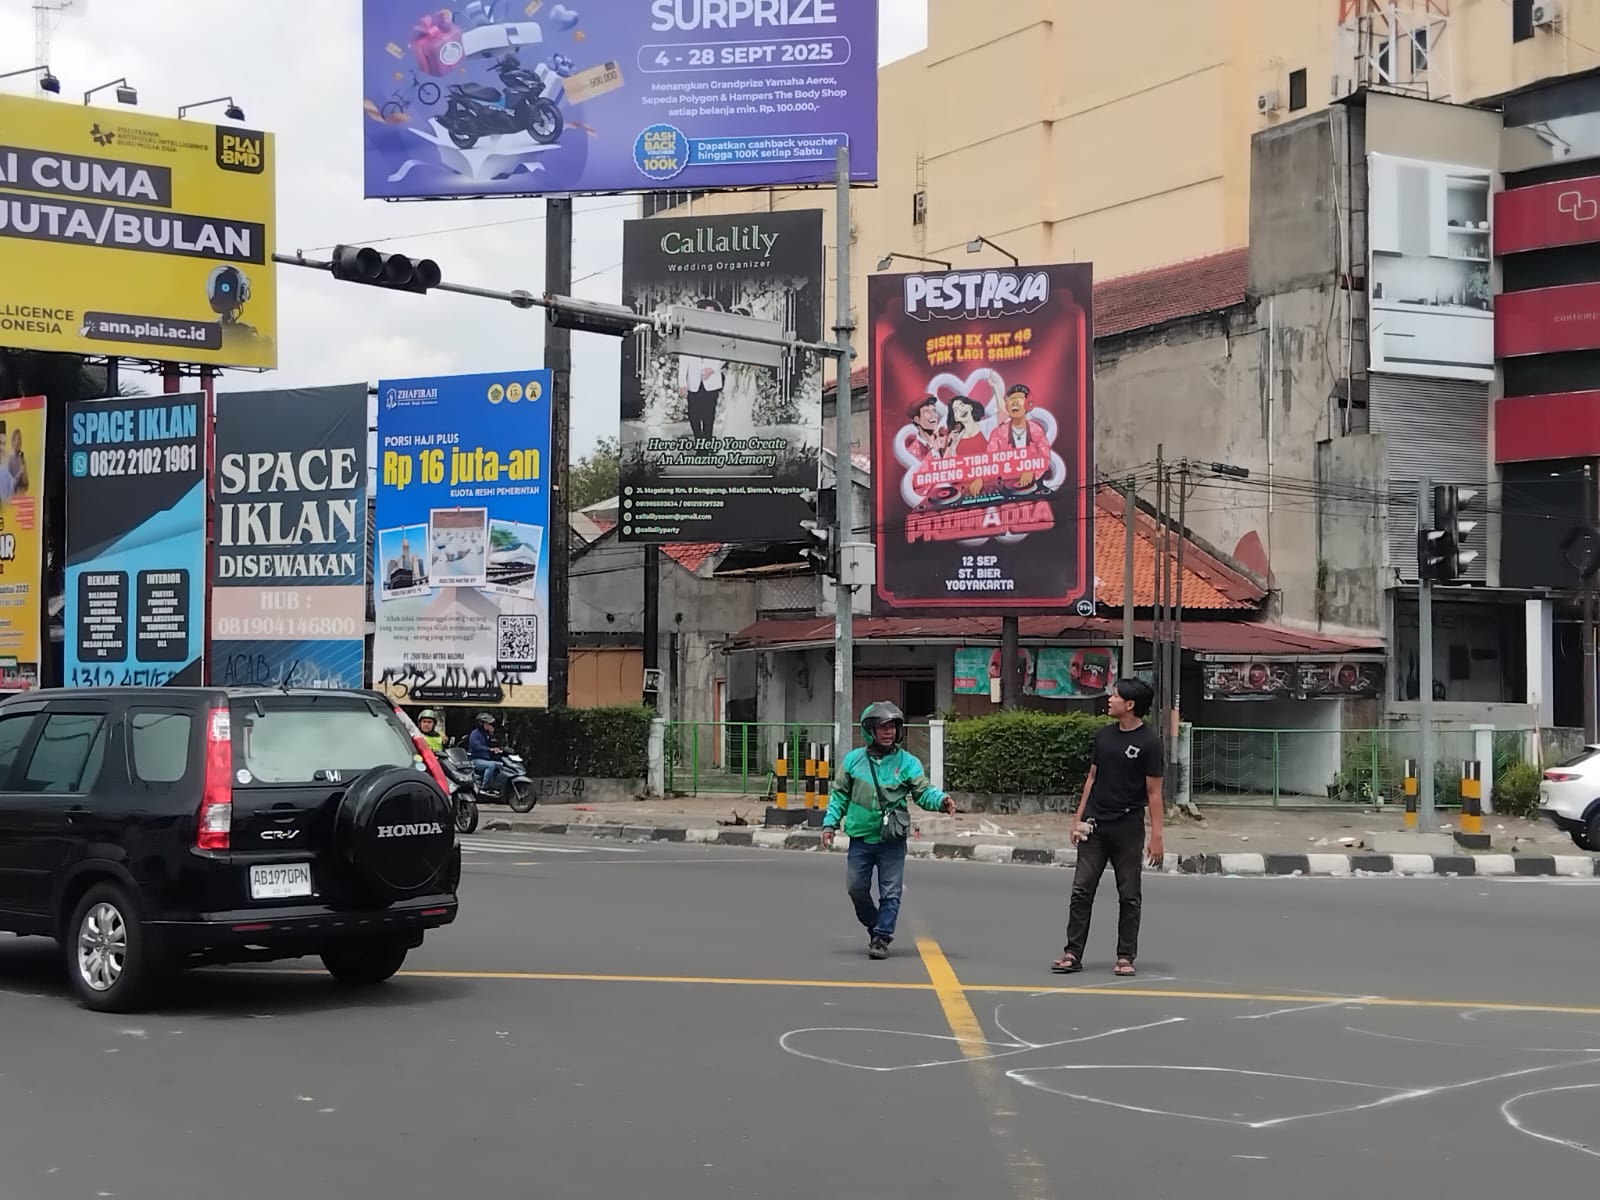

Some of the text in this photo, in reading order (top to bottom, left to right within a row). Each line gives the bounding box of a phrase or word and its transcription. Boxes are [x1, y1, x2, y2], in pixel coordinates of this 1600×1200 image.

[651, 0, 837, 31] SURPRIZE
[654, 51, 669, 67] 4
[689, 48, 715, 65] 28
[720, 46, 776, 64] SEPT
[781, 43, 833, 62] 2025
[652, 76, 837, 92] Menangkan Grandprize Yamaha Aerox,
[641, 88, 847, 106] Sepeda Polygon & Hampers The Body Shop
[668, 103, 821, 117] setiap belanja min. Rp. 100.000,-
[117, 134, 209, 151] ARTIFICIAL INTELLIGENCE
[644, 131, 677, 142] CASH
[698, 137, 838, 153] Dapatkan cashback voucher
[644, 141, 677, 151] BACK
[698, 146, 823, 161] hingga 100K setiap Sabtu
[643, 158, 678, 171] 100K
[31, 157, 159, 200] CUMA
[661, 225, 779, 258] Callalily
[668, 260, 771, 272] Wedding Organizer
[905, 272, 1048, 316] PESTARIA
[99, 320, 206, 342] ann.plai.ac.id
[926, 335, 963, 352] SISCA
[965, 333, 983, 347] EX
[985, 332, 1012, 346] JKT
[927, 352, 953, 366] TAK
[956, 348, 984, 362] LAGI
[397, 388, 438, 399] ZHAFIRAH
[72, 404, 197, 446] SPACE IKLAN
[384, 433, 459, 447] PORSI HAJI PLUS
[648, 437, 787, 453] Here To Help You Create
[90, 444, 197, 477] 0822 2102 1981
[383, 446, 540, 491] Rp 16 juta-an
[657, 453, 776, 467] An Amazing Memory
[931, 450, 1028, 471] TIBA-TIBA KOPLO
[220, 448, 359, 494] SPACE
[916, 458, 1045, 485] BARENG JONO & JONI
[450, 486, 540, 498] KUOTA RESMI PEMERINTAH
[219, 499, 358, 547] IKLAN
[218, 553, 356, 578] DISEWAKAN
[962, 556, 998, 567] 12 SEP
[87, 575, 120, 586] REKLAME
[146, 573, 181, 585] INTERIOR
[958, 568, 1001, 579] ST. BIER
[945, 579, 1015, 591] YOGYAKARTA
[260, 592, 300, 610] HUB
[218, 617, 355, 636] 081904146800
[224, 654, 270, 683] ACAB
[260, 829, 300, 840] CR-V
[377, 822, 443, 838] HONDA
